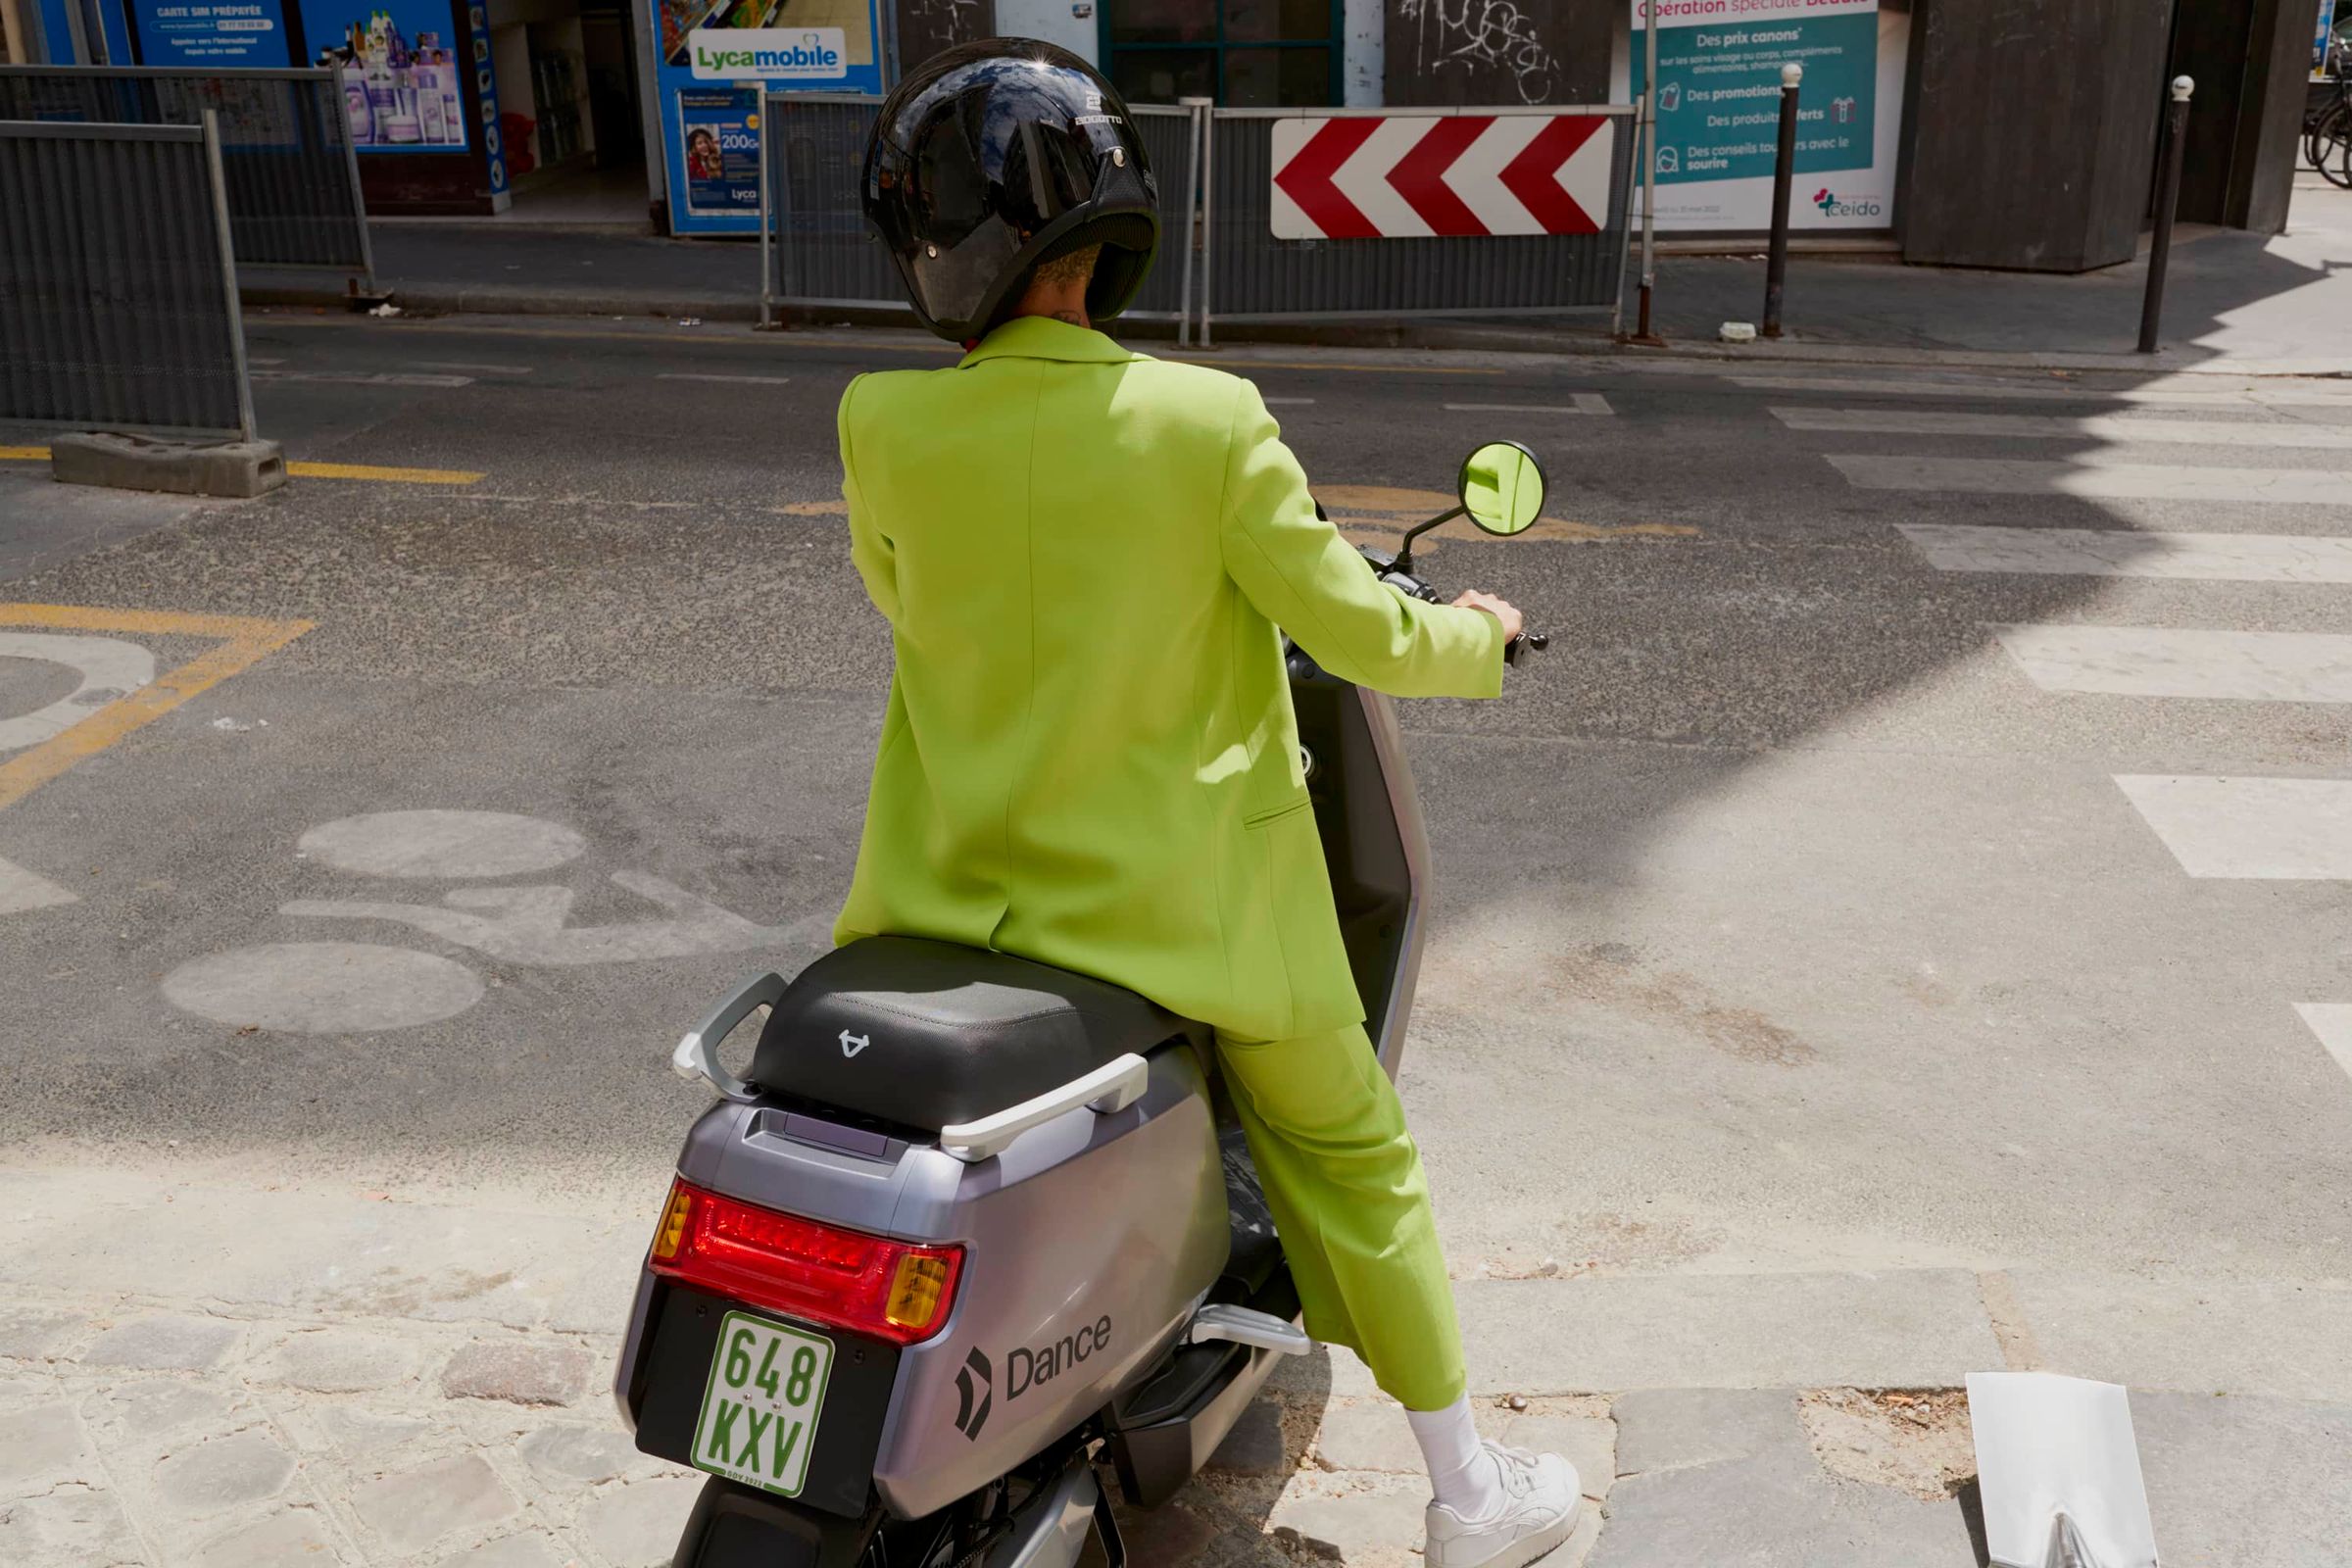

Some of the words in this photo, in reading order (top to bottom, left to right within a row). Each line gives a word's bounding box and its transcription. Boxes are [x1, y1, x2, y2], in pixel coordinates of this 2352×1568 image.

[157, 7, 188, 17] CARTE
[191, 7, 211, 17] SIM
[213, 5, 262, 16] PRÉPAYÉE
[1697, 34, 1721, 47] Des
[1723, 31, 1748, 48] prix
[698, 46, 838, 71] Lycamobile
[1688, 90, 1709, 101] Des
[1707, 116, 1728, 126] Des
[1688, 146, 1709, 158] Des
[1712, 143, 1757, 156] conseils
[1808, 139, 1836, 149] avec
[1838, 136, 1849, 147] le
[1687, 157, 1728, 171] sourire
[731, 189, 757, 200] Lyca
[1006, 1315, 1111, 1401] Dance
[724, 1329, 817, 1407] 648
[707, 1398, 804, 1480] KXV
